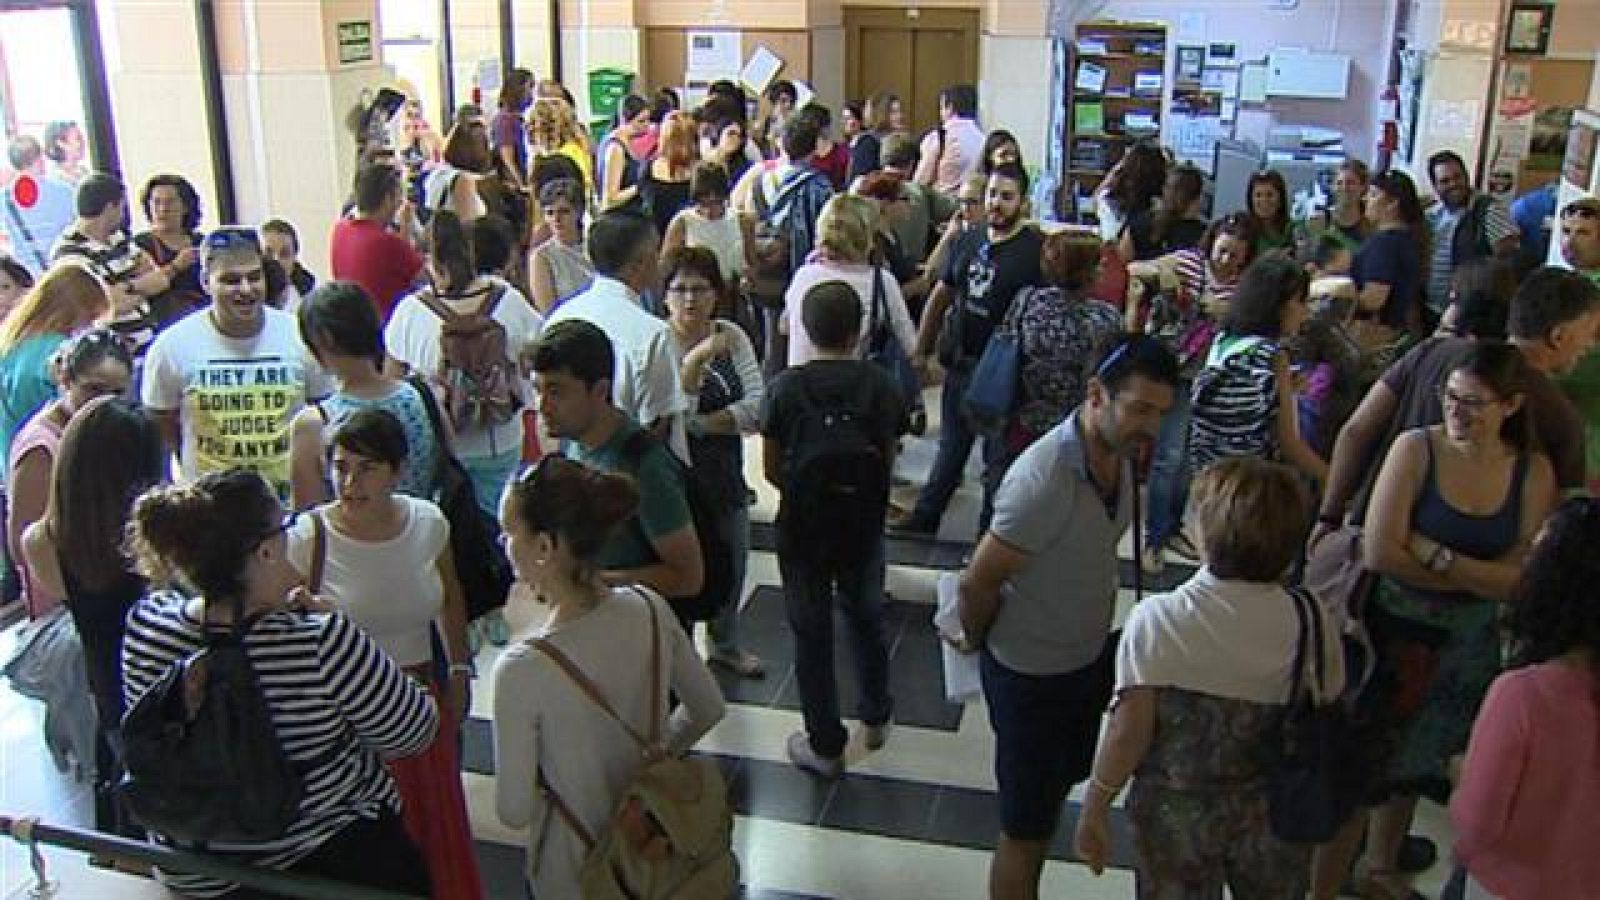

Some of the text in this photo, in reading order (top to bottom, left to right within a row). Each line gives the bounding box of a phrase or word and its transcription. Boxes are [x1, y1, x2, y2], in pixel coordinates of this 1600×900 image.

[197, 367, 288, 386] THEY ARE
[199, 391, 286, 411] GOING TO
[219, 415, 276, 435] JUDGE
